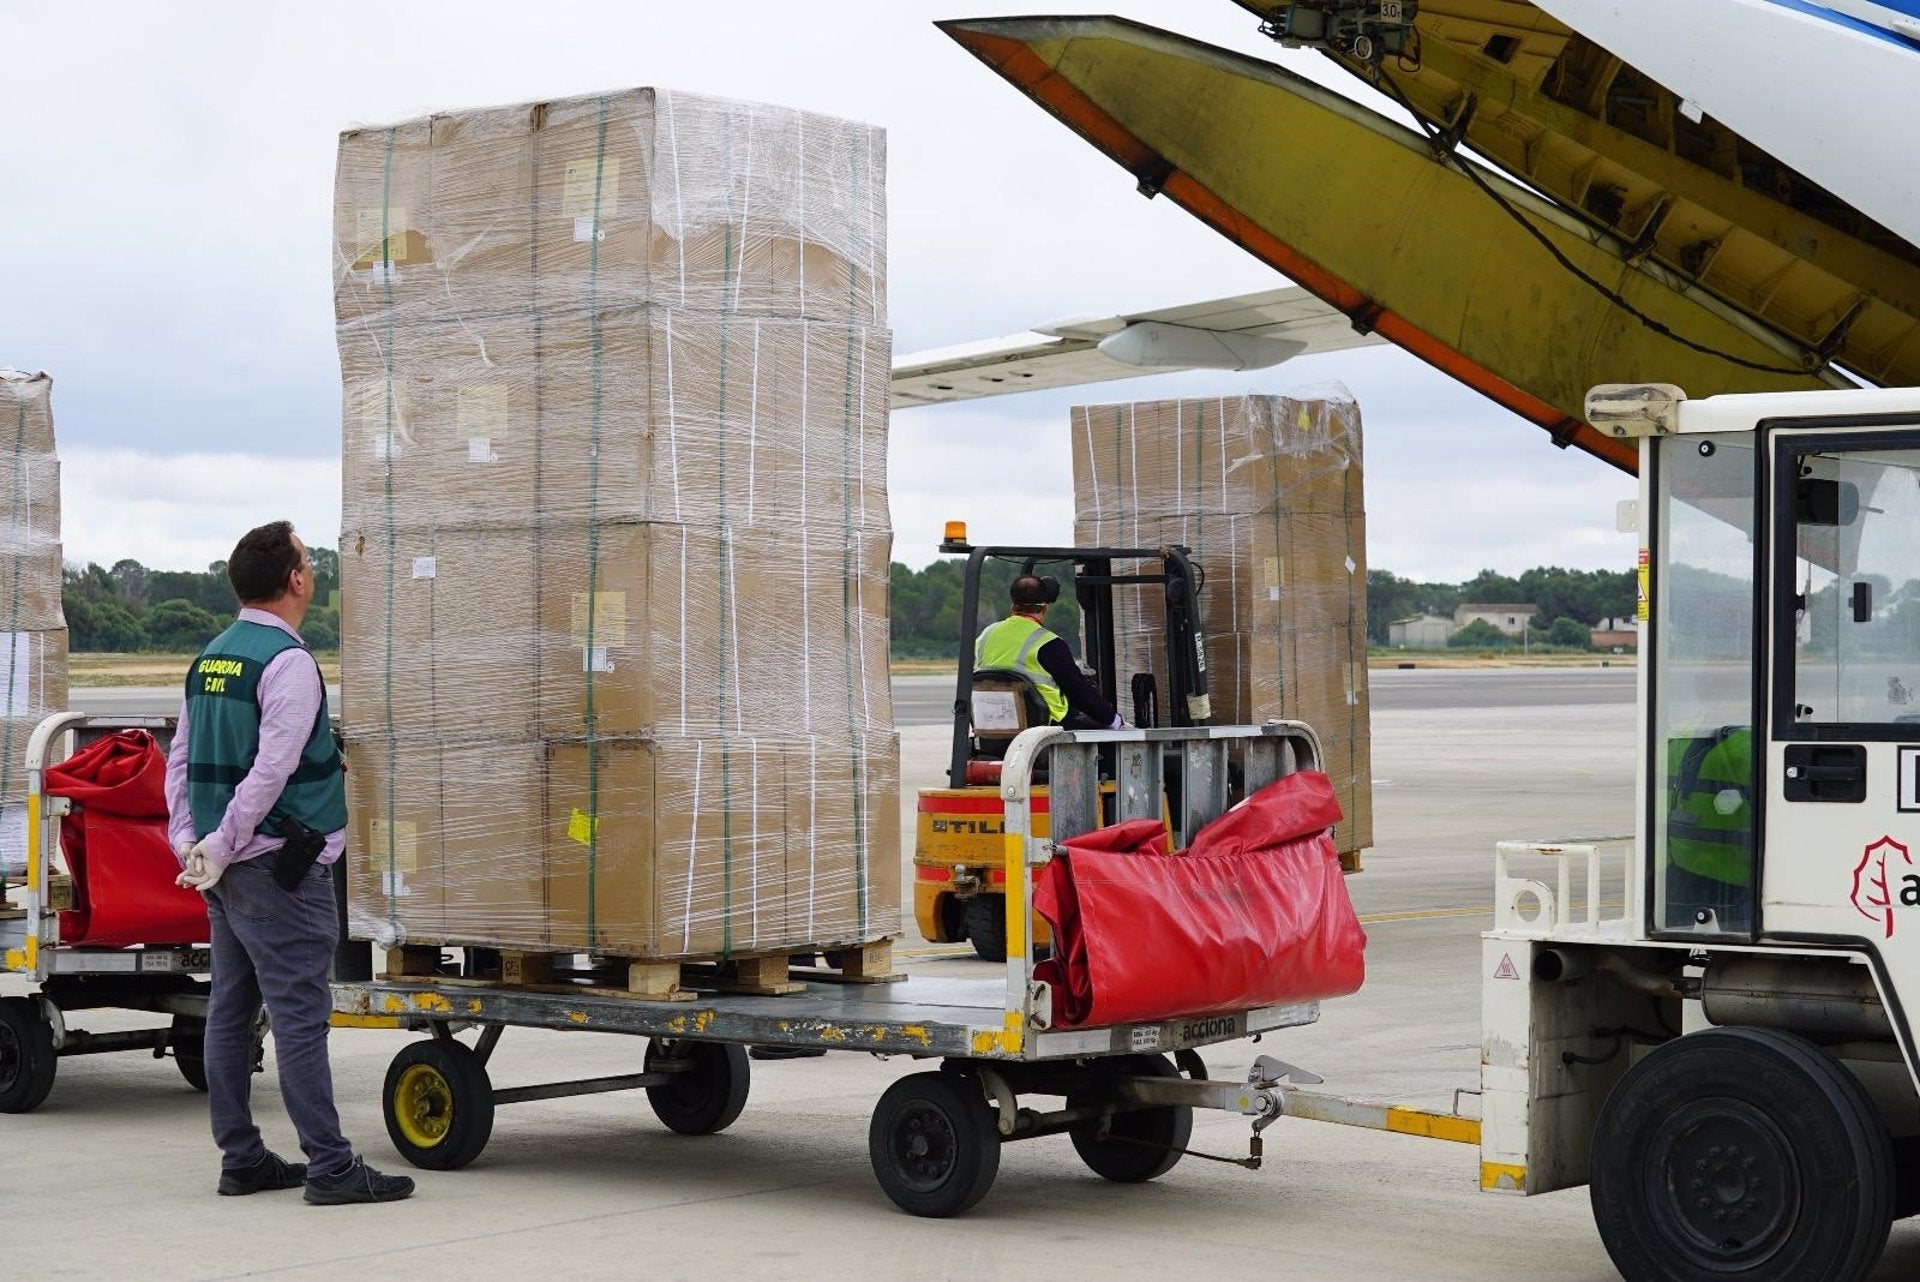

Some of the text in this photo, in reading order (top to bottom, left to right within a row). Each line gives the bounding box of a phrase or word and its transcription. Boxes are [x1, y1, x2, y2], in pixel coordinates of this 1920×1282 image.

[198, 660, 243, 676] GUARDIA
[933, 820, 1005, 833] STIL
[181, 953, 211, 968] acc
[1183, 1017, 1235, 1042] acciona
